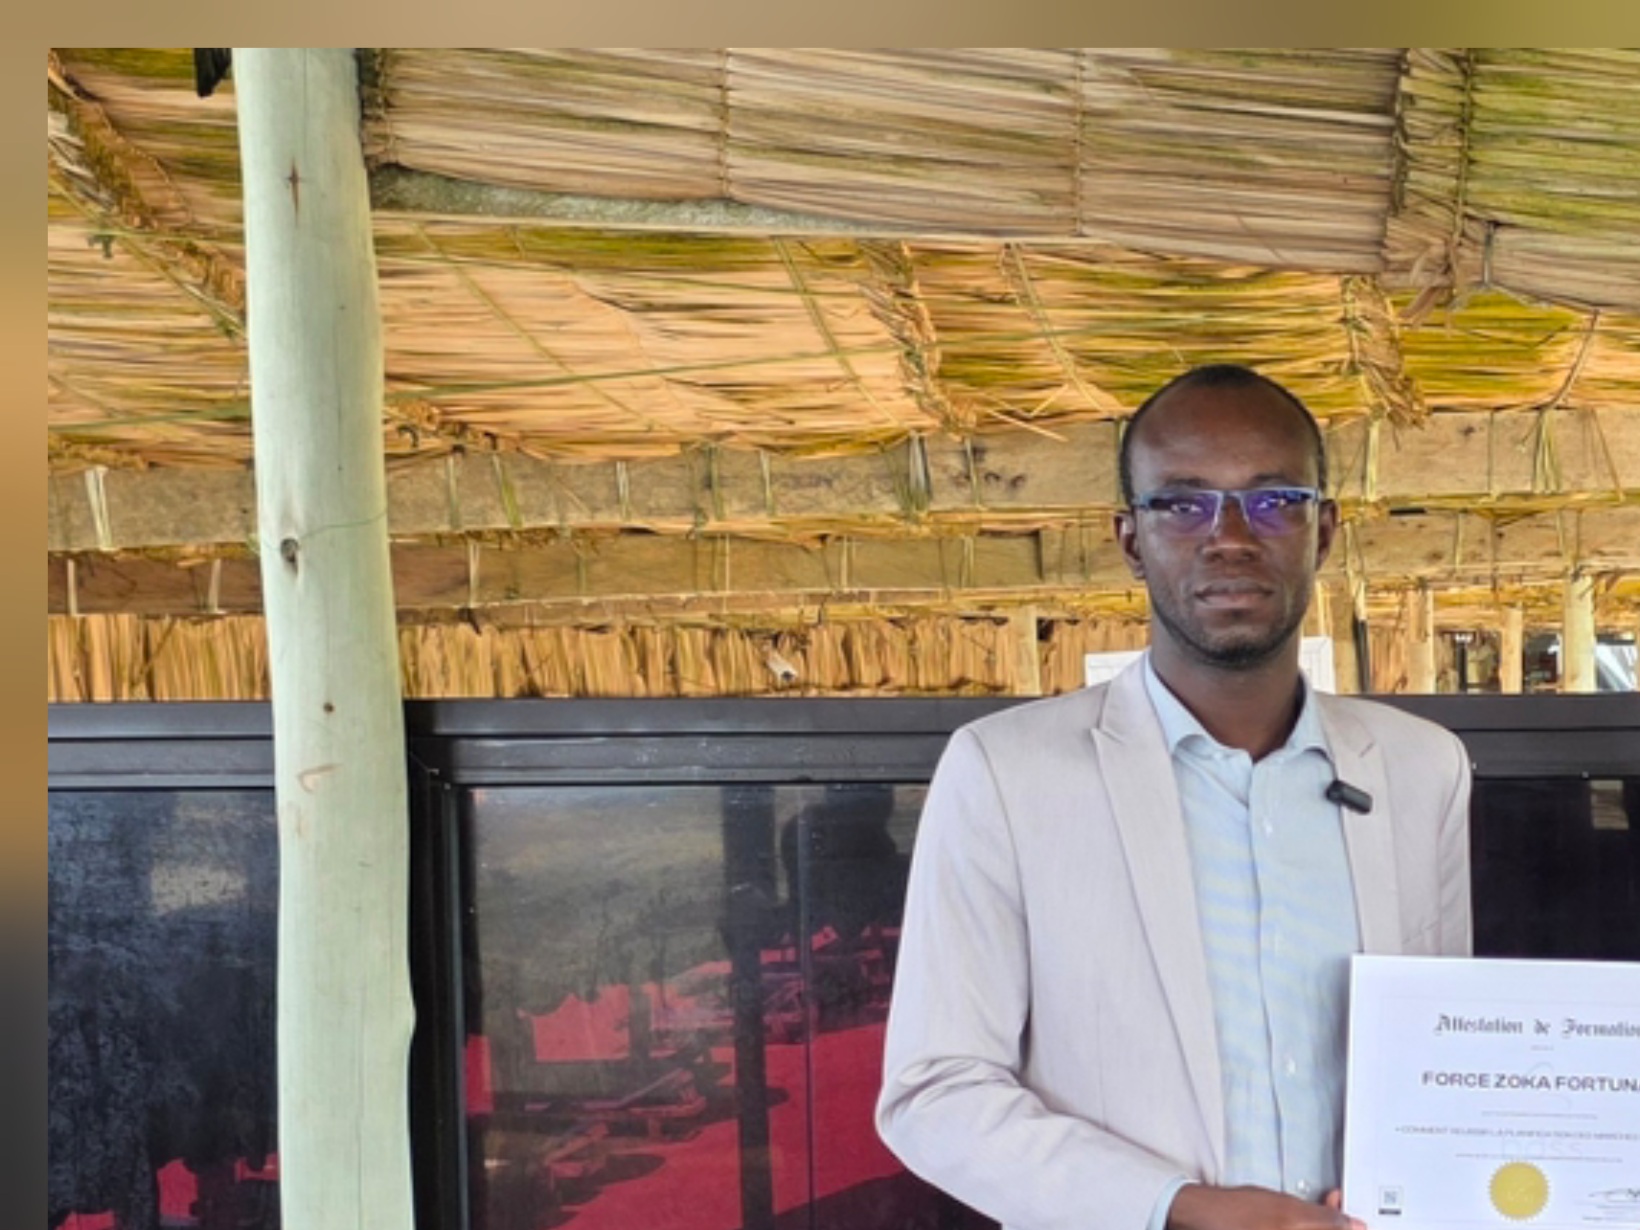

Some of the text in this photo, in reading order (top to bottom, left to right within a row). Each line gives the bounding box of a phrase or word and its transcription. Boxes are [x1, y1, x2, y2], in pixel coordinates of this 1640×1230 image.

[1433, 1013, 1523, 1037] Attestation
[1533, 1019, 1550, 1036] de
[1422, 1071, 1492, 1089] FORCE
[1493, 1072, 1551, 1091] ZOKA
